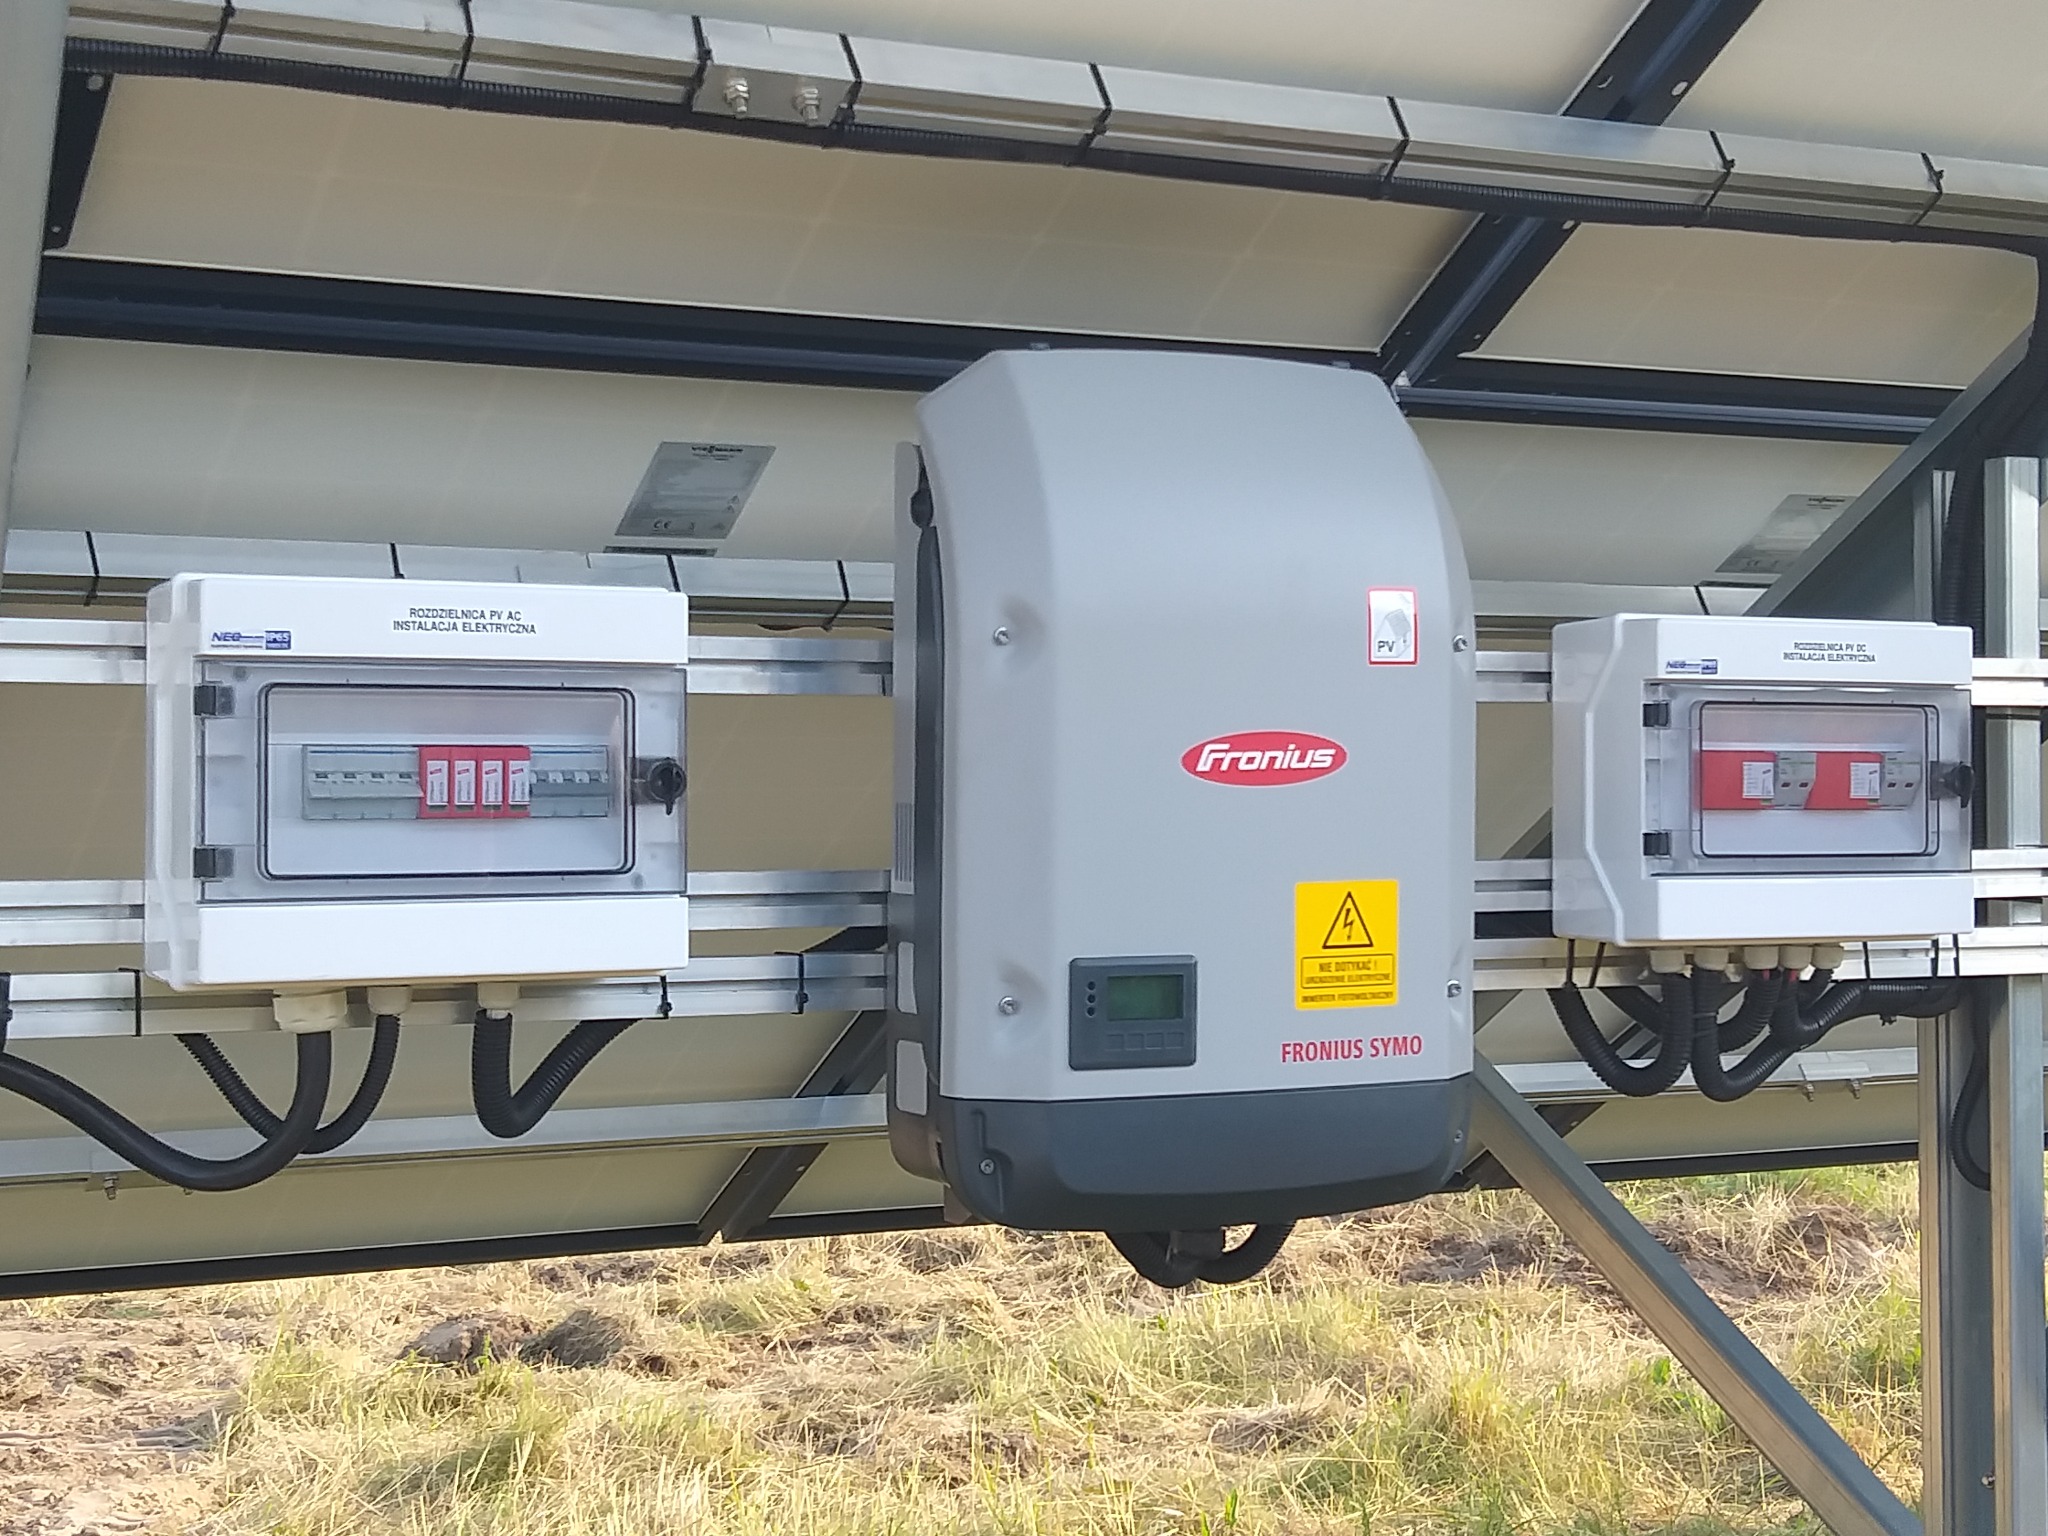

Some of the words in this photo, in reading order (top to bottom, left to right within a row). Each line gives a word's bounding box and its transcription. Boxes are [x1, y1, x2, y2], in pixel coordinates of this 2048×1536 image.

[409, 607, 486, 620] ROZDZIELNICA
[489, 609, 503, 621] PV
[506, 610, 522, 622] AC
[393, 620, 459, 632] INSTALACJA
[461, 621, 537, 635] ELEKTRYCZNA
[1377, 640, 1396, 653] PV
[1845, 643, 1855, 652] PV
[1856, 643, 1867, 653] DC
[1783, 652, 1826, 661] INSTALACJA
[1827, 653, 1876, 663] ELEKTRYCZNA
[1196, 743, 1337, 772] Fronius
[1318, 961, 1333, 973] NIE
[1334, 957, 1372, 972] DOTYKAĆ
[1281, 1038, 1363, 1063] FRONIUS
[1369, 1034, 1422, 1058] SYMO
